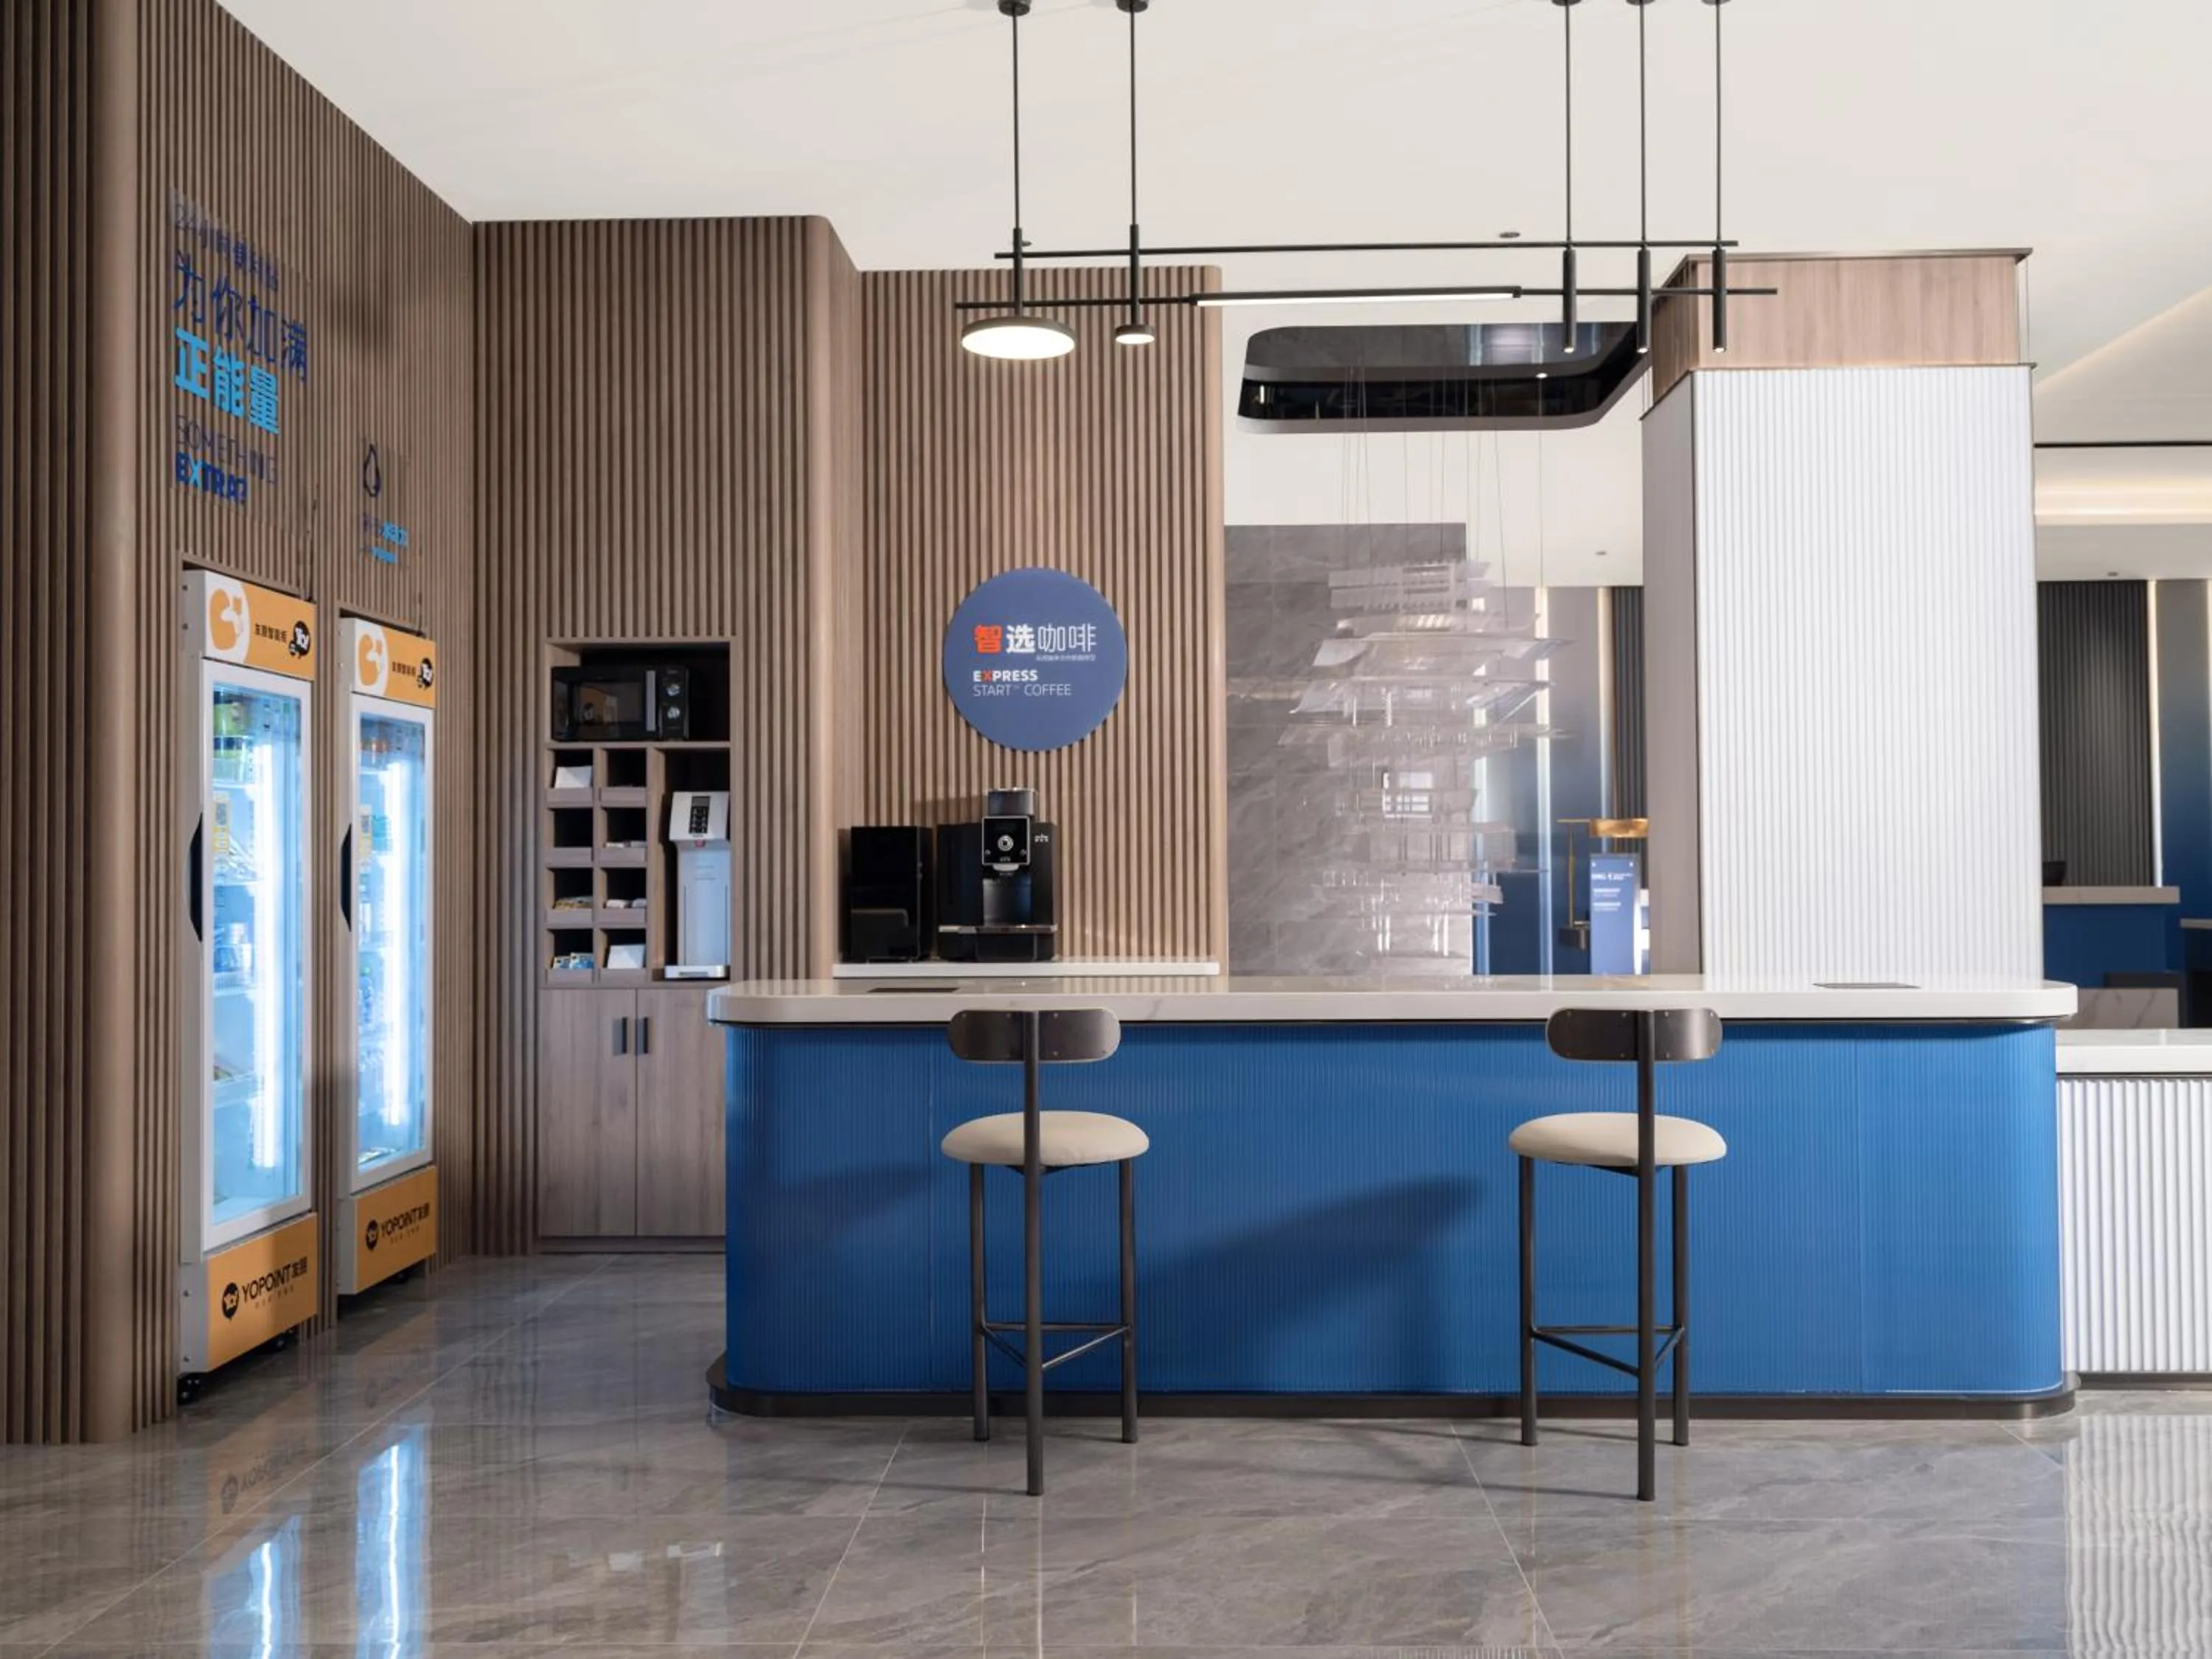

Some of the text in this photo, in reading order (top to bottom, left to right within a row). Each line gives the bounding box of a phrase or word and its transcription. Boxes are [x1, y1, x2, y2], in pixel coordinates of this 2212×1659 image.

[173, 249, 307, 384] 为你加满
[175, 326, 280, 434] 正能量
[973, 623, 1097, 654] 智选咖啡
[973, 669, 1039, 682] EXPRESS
[1024, 684, 1071, 696] COFFEE
